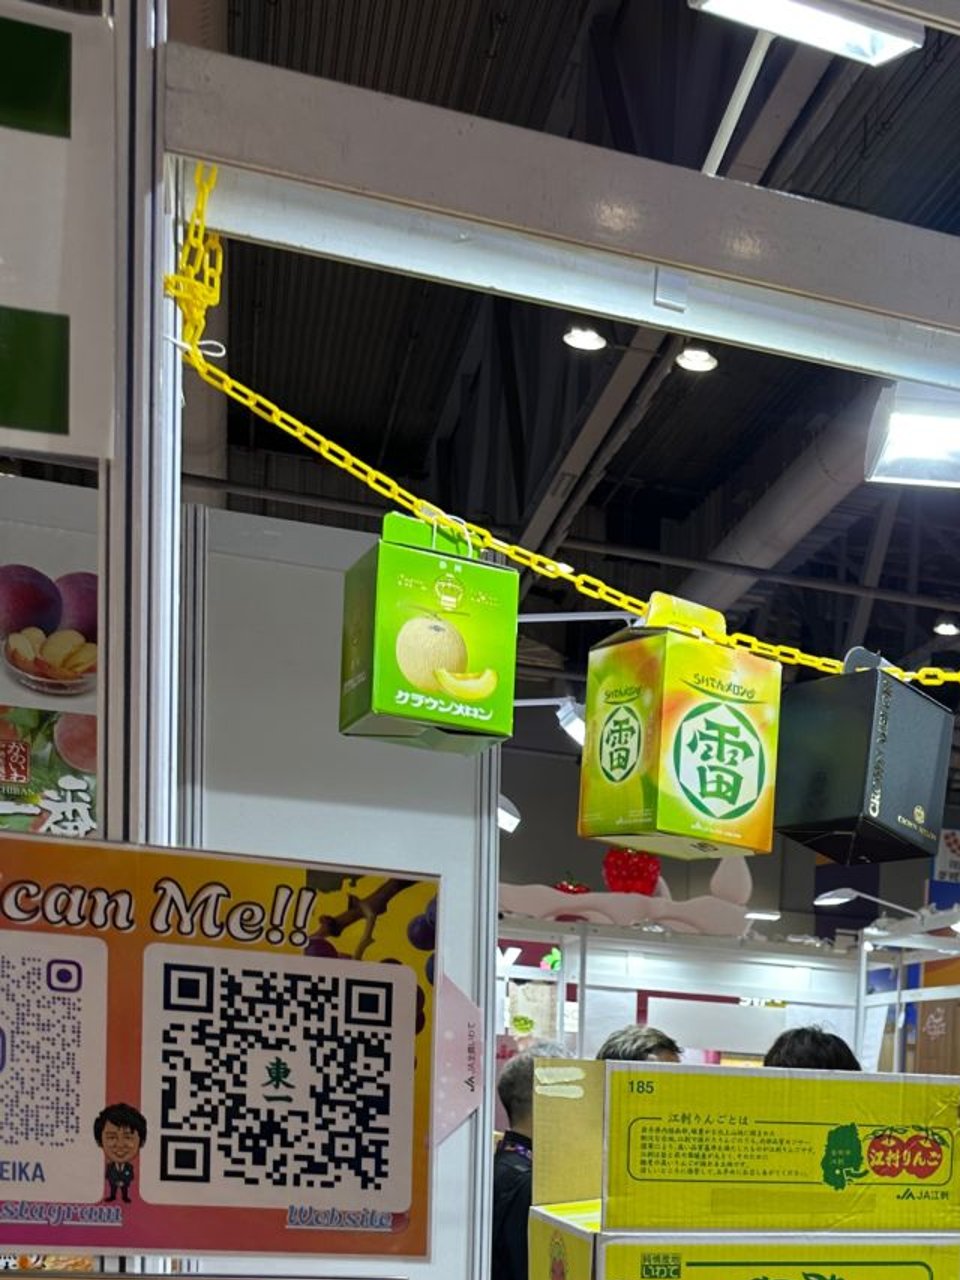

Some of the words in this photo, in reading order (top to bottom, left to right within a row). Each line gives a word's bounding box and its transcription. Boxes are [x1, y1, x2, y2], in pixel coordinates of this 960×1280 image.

[395, 689, 493, 721] クラウンメロン
[149, 877, 317, 948] Me!!
[628, 1080, 655, 1095] 185
[667, 1113, 748, 1126] 江刺りんごとは
[287, 1205, 393, 1228] Website
